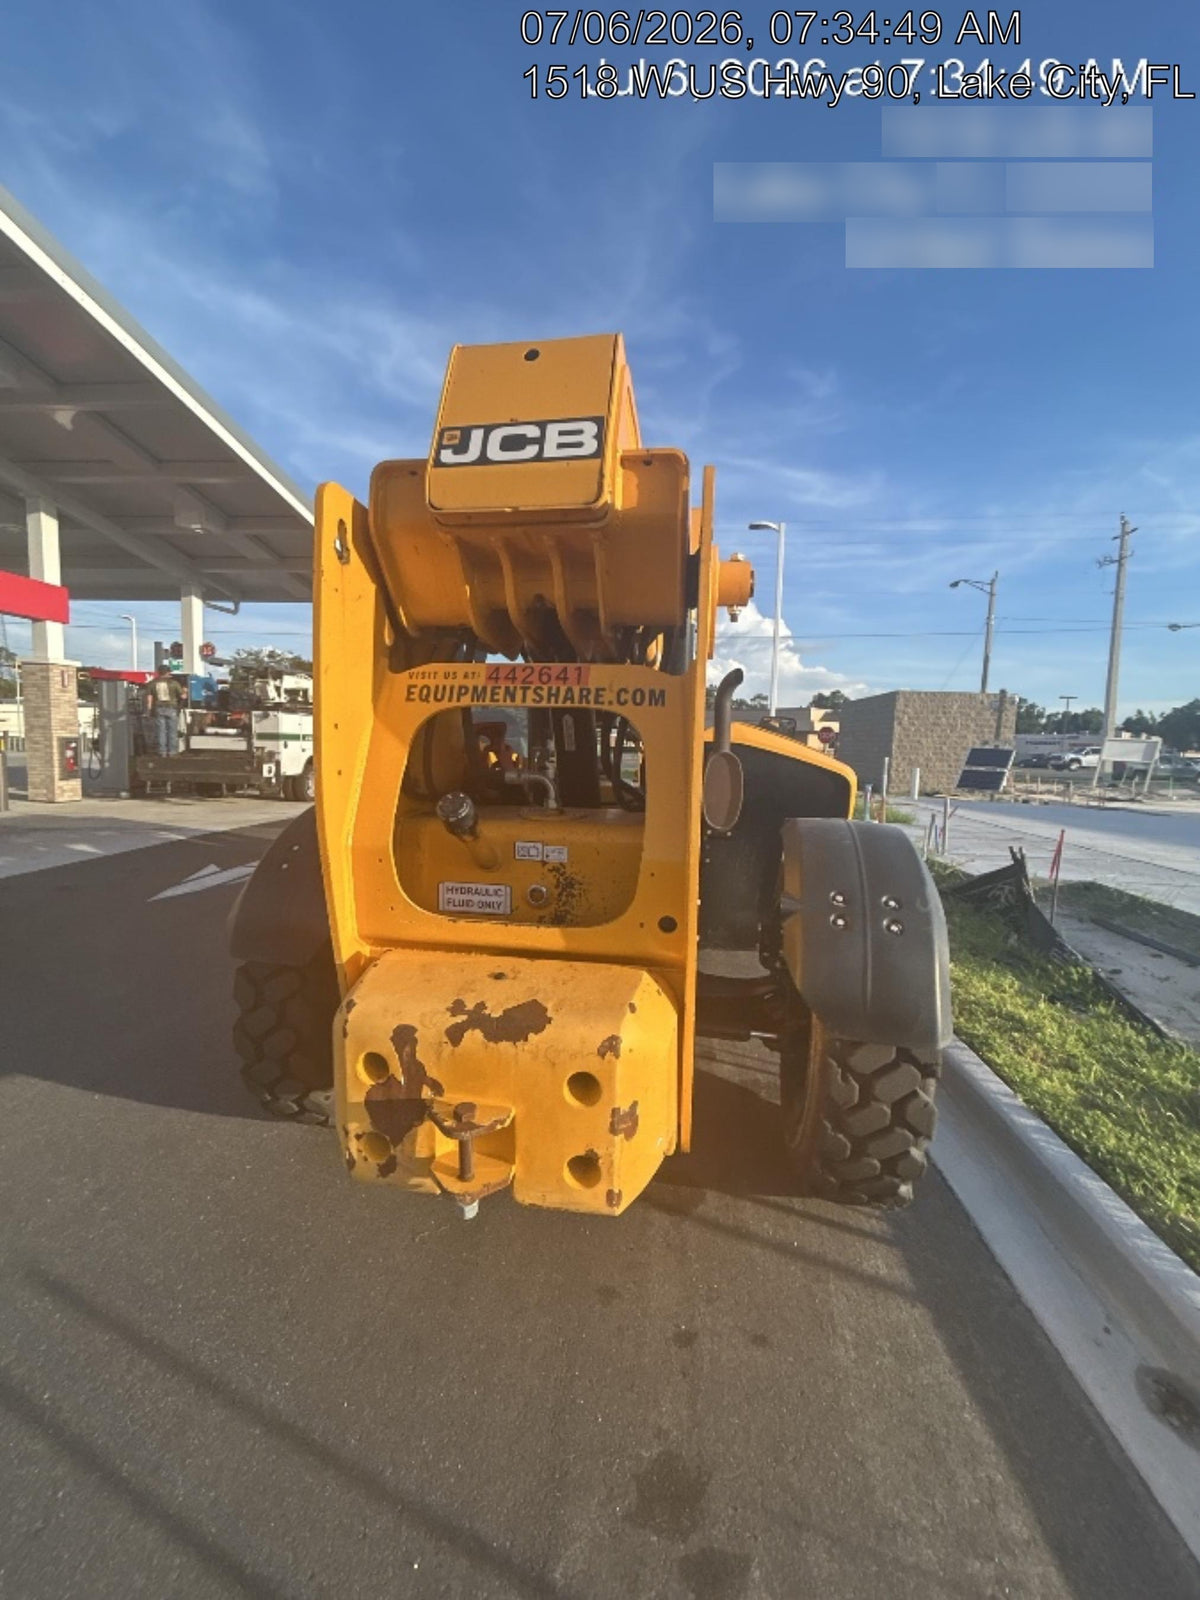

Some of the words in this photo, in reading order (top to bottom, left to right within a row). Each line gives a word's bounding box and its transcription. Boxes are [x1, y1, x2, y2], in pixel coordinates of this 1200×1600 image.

[439, 420, 599, 464] JCB
[408, 671, 438, 680] VISIT
[443, 671, 458, 680] US
[486, 666, 583, 685] 442641
[405, 684, 666, 706] EQUIPMENTSHARE.COM
[446, 886, 504, 897] HYDRAULIC
[447, 898, 475, 908] FLUID
[477, 900, 503, 910] ONLY
